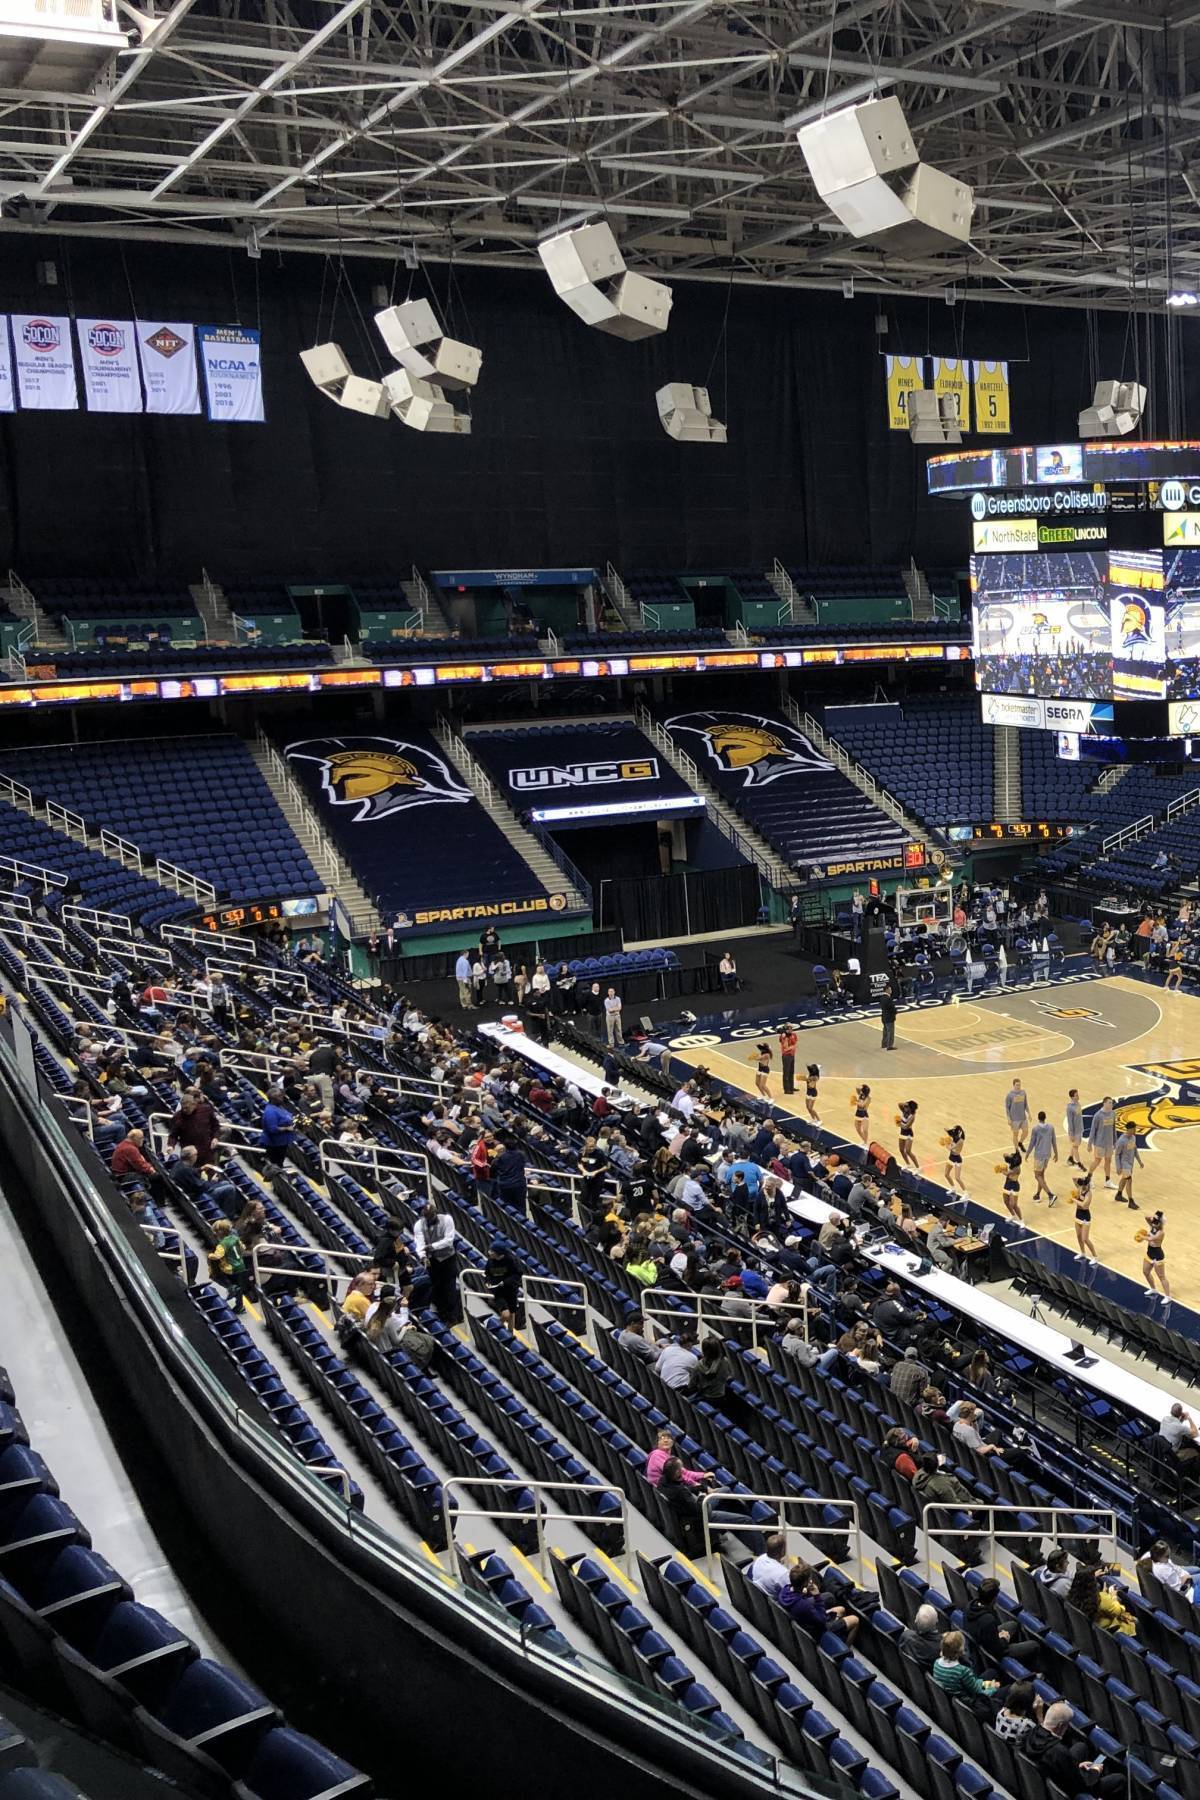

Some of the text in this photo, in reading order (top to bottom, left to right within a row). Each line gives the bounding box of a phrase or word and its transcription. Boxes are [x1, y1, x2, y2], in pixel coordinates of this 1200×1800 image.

[22, 325, 60, 345] SOCON
[88, 329, 125, 349] SOCON
[156, 339, 178, 347] NIT
[204, 334, 256, 344] BASKETBALL
[208, 359, 246, 371] NCAA
[988, 395, 997, 417] 5
[988, 490, 1107, 514] Greensboro Coliseum
[992, 528, 1036, 543] NorthState
[1001, 703, 1037, 714] ticketmaster
[515, 760, 655, 788] UNCG
[827, 859, 892, 876] SPARTAN
[415, 899, 547, 924] SPARTAN CLUB
[632, 1185, 644, 1197] 20
